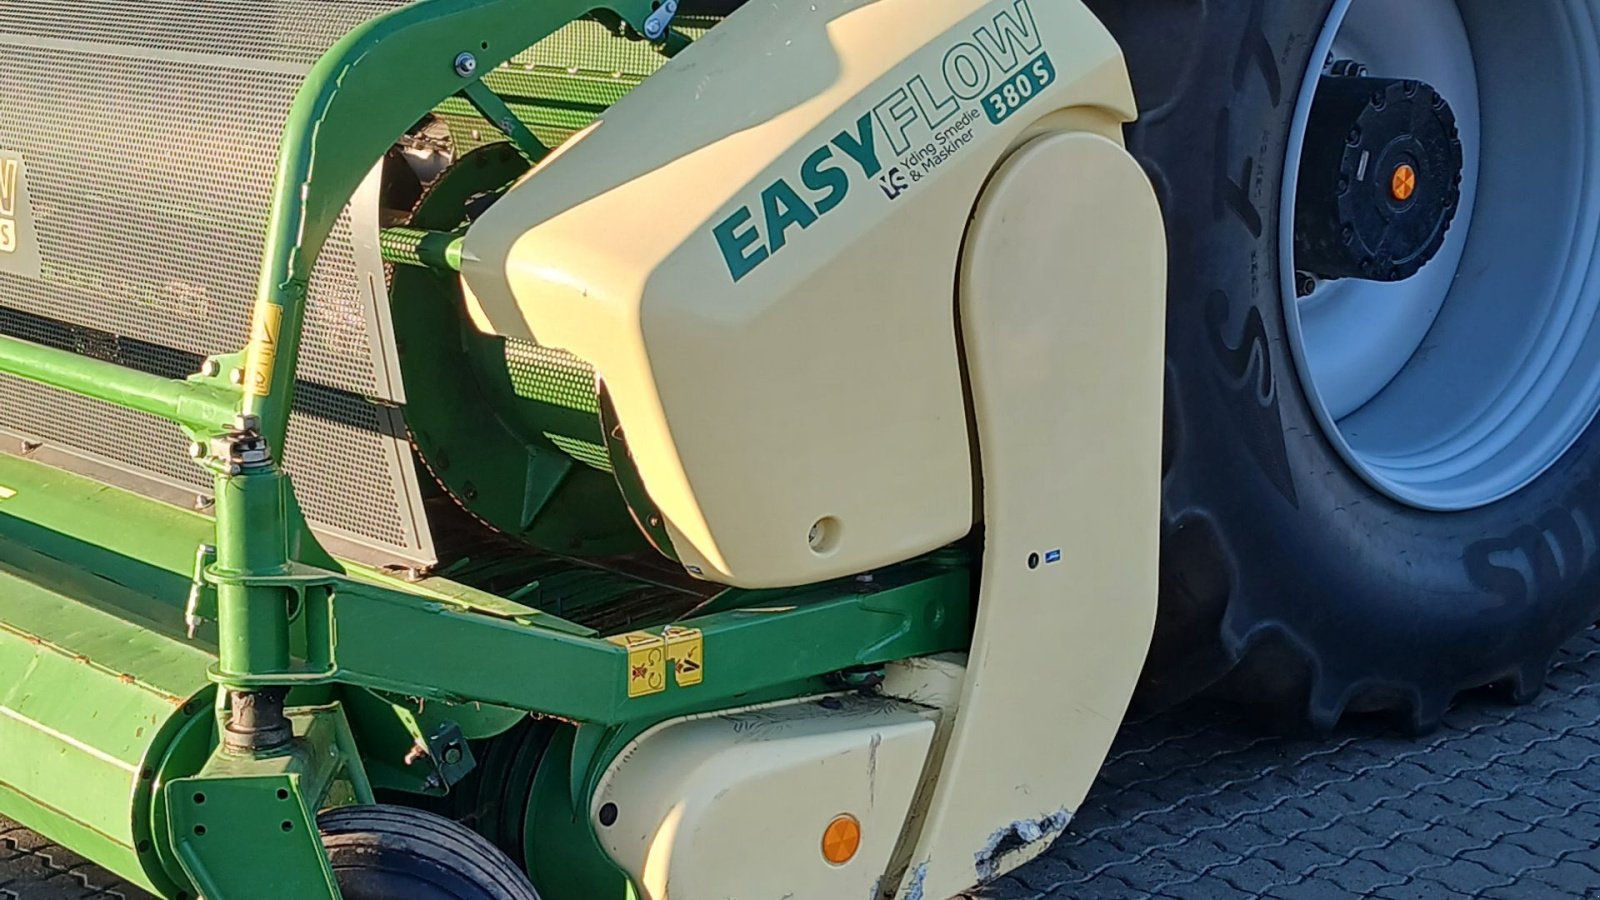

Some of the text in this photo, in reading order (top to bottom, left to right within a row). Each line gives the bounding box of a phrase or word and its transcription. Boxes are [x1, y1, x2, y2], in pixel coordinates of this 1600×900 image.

[989, 59, 1050, 119] 380 S
[712, 0, 1042, 283] EASYFLOW
[900, 107, 981, 171] Yding Smedie
[909, 128, 975, 182] & Maskiner
